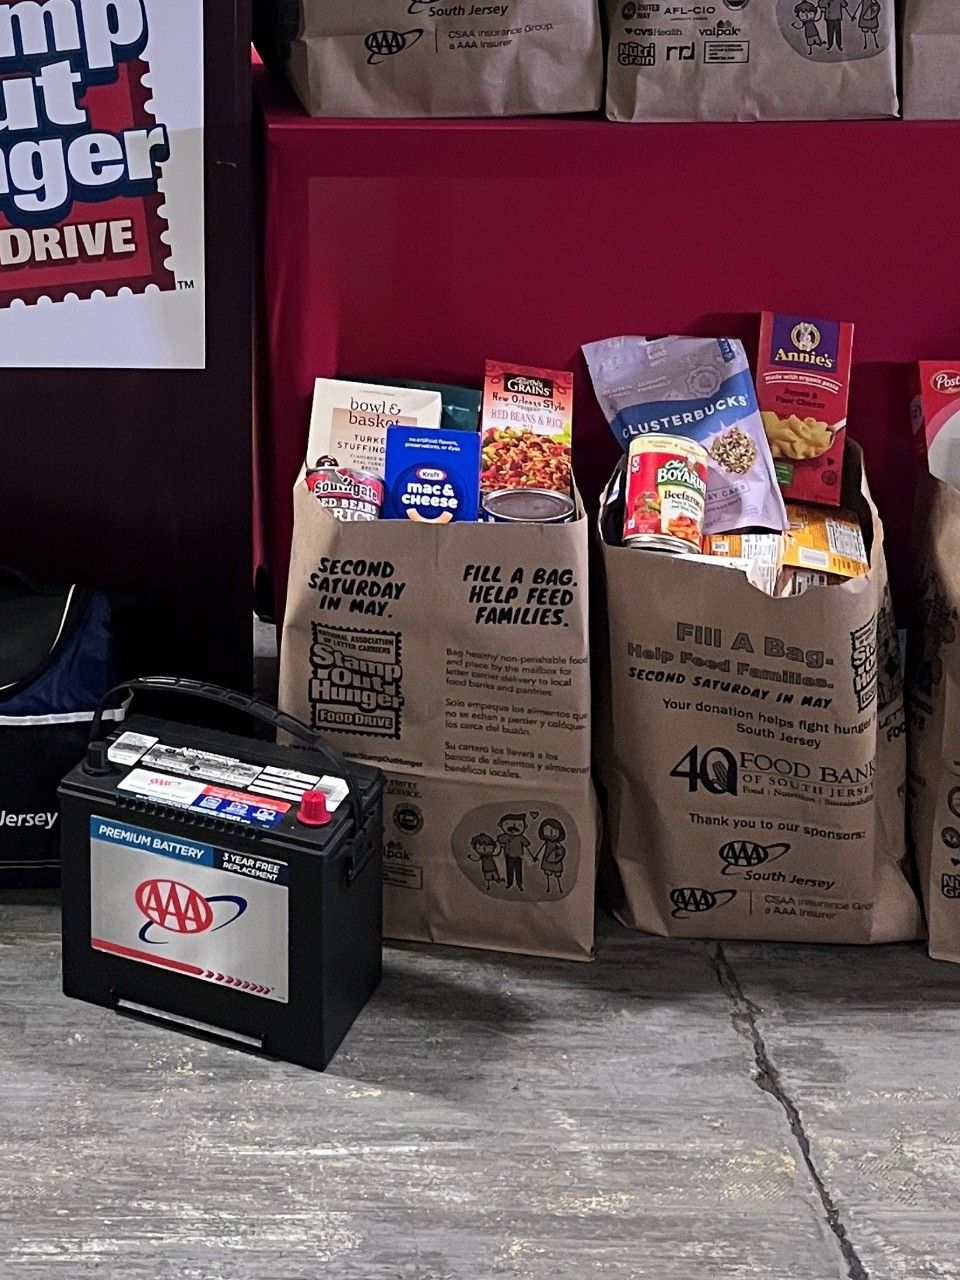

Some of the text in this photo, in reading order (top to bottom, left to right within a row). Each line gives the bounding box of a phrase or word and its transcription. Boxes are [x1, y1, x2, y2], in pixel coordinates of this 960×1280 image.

[429, 5, 509, 17] South Jersey
[699, 26, 738, 38] valpak
[775, 349, 833, 368] Annie's
[508, 380, 551, 396] GRAINS
[351, 397, 401, 415] bowl &
[493, 392, 565, 411] New Orleans Style
[492, 409, 544, 426] RED BEANS &
[622, 395, 747, 439] CLUSTERBUCKS
[422, 471, 440, 479] Kraft
[408, 483, 454, 497] mac &
[463, 565, 578, 587] FILL A BAG.
[469, 585, 574, 606] HELP FEED
[475, 607, 569, 627] FAMILIES.
[676, 622, 834, 668] Fill A Bag.
[465, 662, 488, 670] place
[492, 663, 502, 672] by
[505, 665, 520, 673] the
[522, 667, 556, 675] mailbox
[628, 667, 833, 709] SECOND SATURDAY IN MAY
[99, 825, 205, 860] PREMIUM BATTERY
[223, 853, 280, 874] 3 YEAR FREE
[223, 861, 278, 882] REPLACEMENT
[135, 879, 213, 934] AAA
